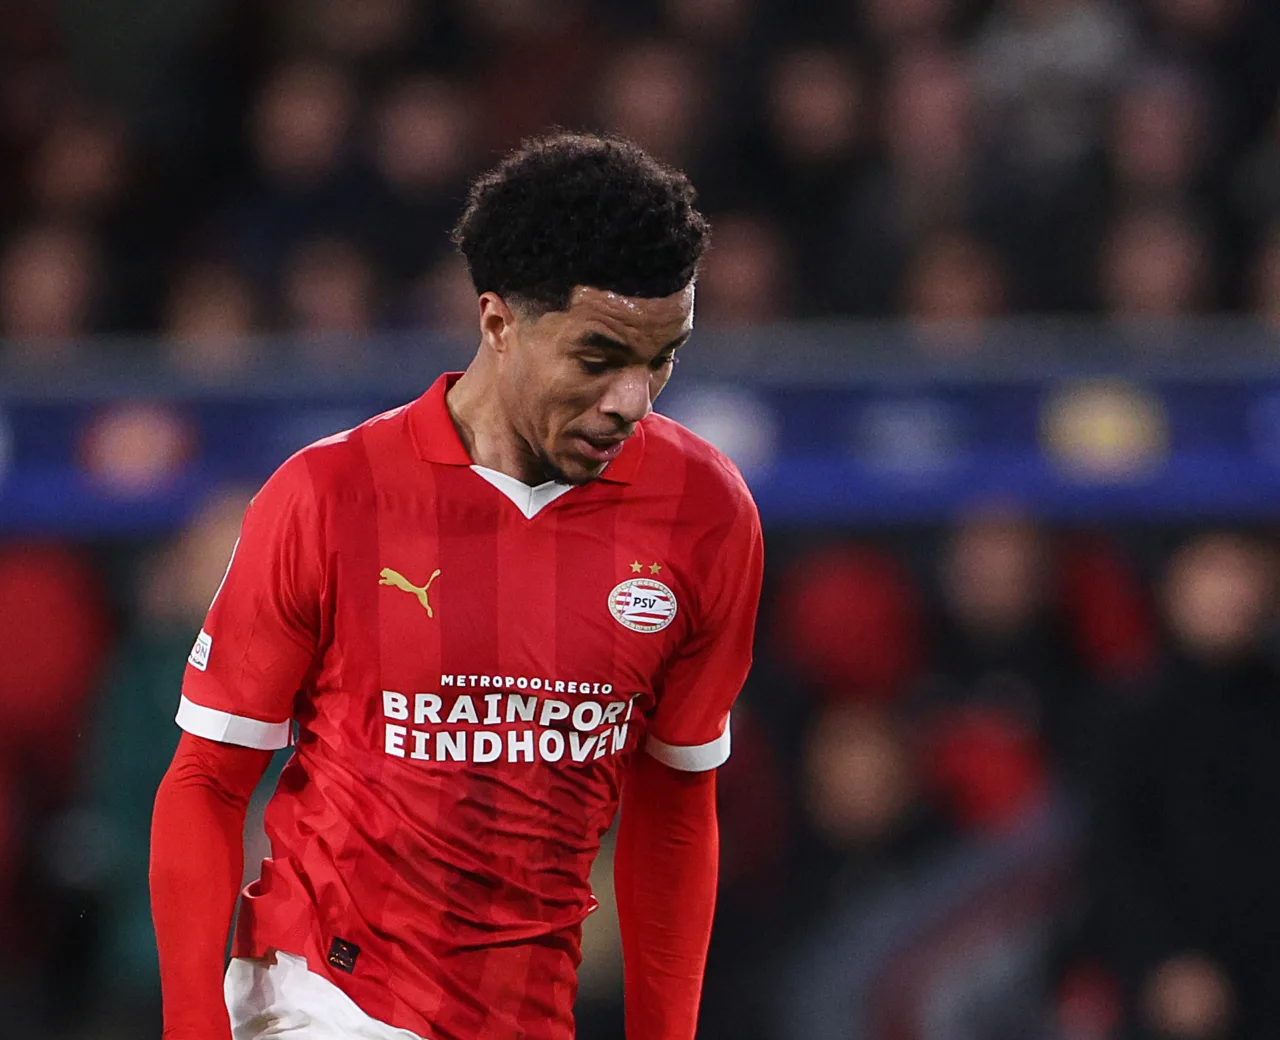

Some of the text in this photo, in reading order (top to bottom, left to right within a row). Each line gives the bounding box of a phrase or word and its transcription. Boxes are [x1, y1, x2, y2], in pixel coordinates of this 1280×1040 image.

[632, 596, 657, 609] PSV
[440, 674, 613, 695] METROPOOLREGIO
[385, 723, 629, 763] EINDHOVEN
